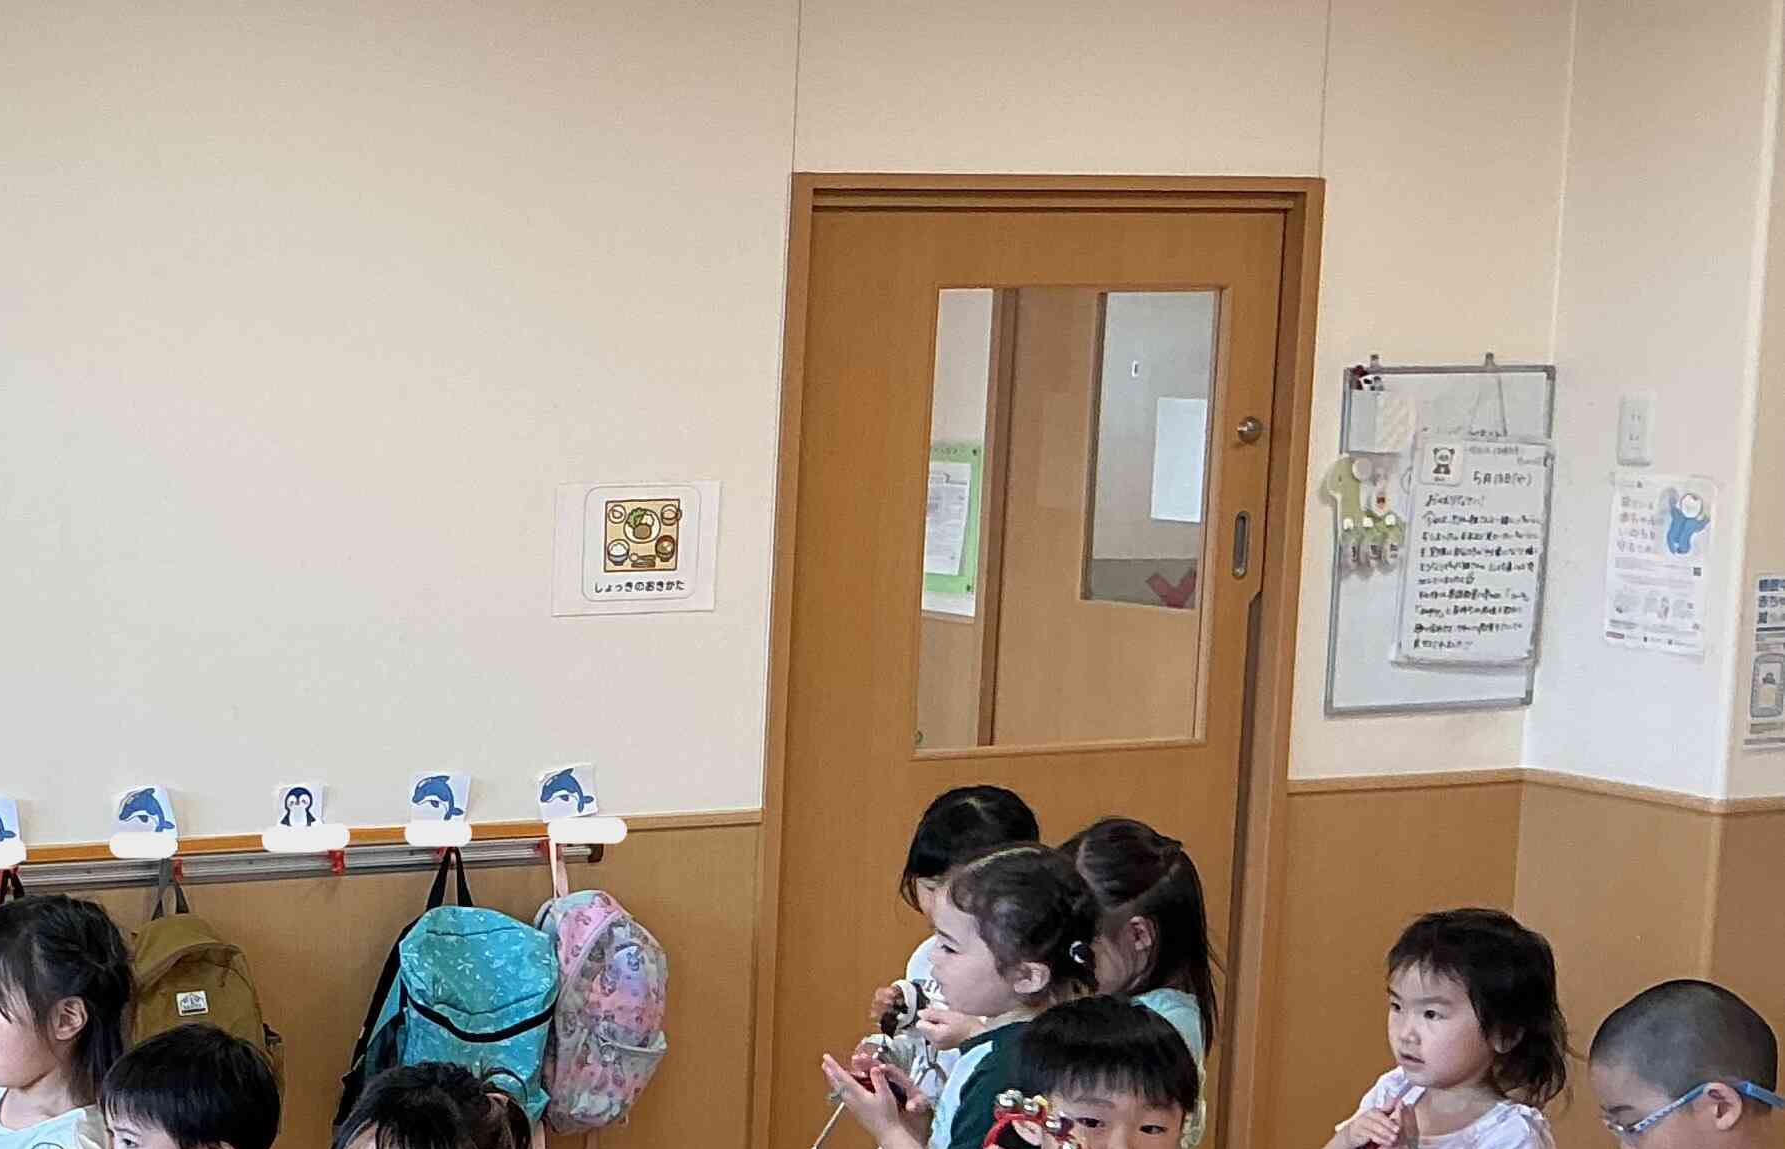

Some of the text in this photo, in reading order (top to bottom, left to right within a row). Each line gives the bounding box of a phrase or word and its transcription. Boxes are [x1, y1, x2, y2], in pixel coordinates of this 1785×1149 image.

[595, 580, 685, 593] しょっきのおきかた
